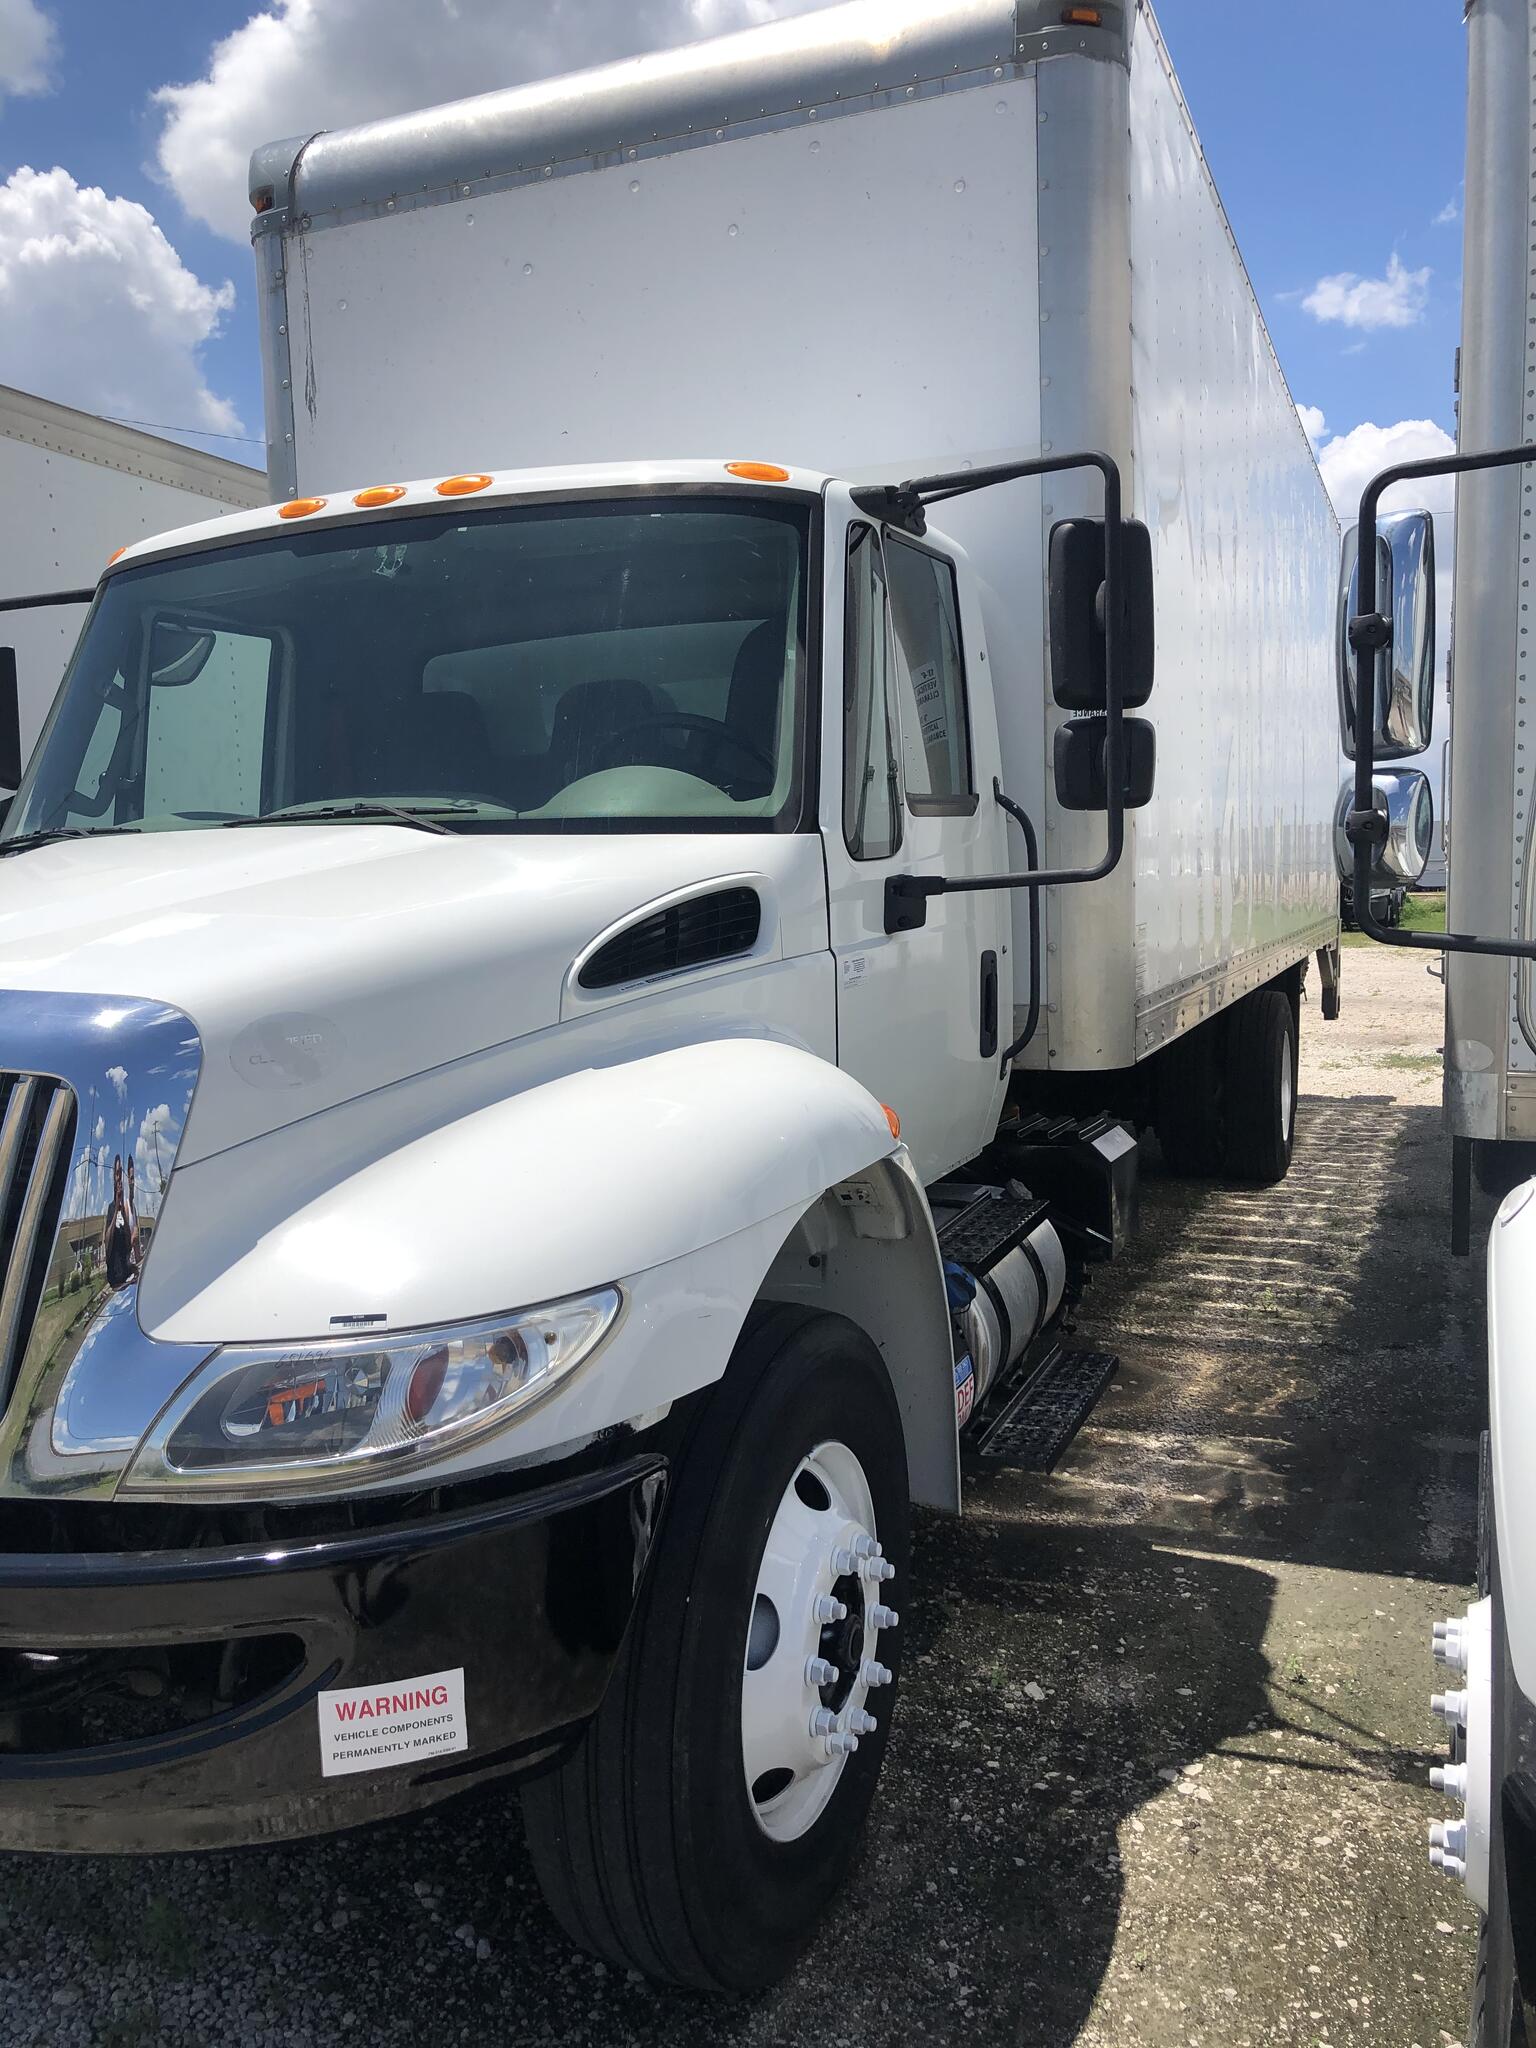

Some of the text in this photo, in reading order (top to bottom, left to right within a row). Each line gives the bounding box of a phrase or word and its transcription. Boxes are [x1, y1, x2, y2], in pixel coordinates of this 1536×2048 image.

[335, 1685, 448, 1721] WARNING
[334, 1714, 453, 1742] VEHICLE COMPONENTS
[332, 1741, 410, 1760] PERMANENTLY
[413, 1731, 457, 1748] MARKED
